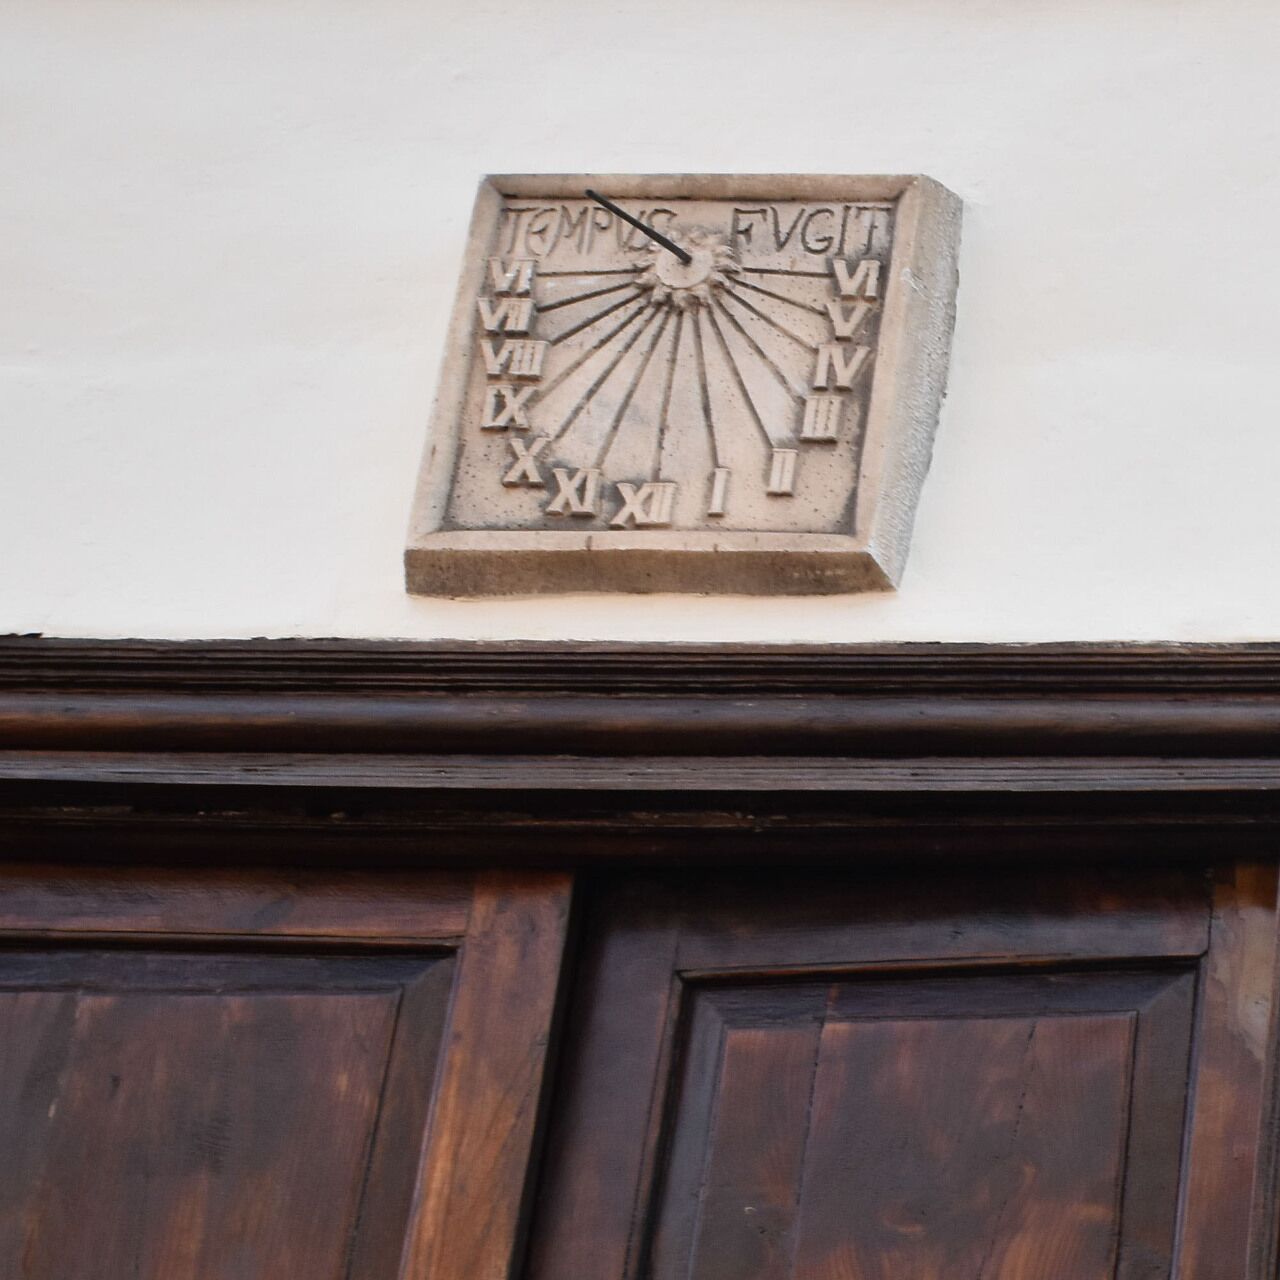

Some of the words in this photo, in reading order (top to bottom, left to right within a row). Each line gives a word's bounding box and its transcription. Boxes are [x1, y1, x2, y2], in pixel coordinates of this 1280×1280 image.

[733, 205, 893, 257] FVGIT
[488, 256, 536, 295] VI
[833, 256, 880, 301] VI
[477, 298, 534, 335] VII
[826, 303, 872, 340] V
[813, 344, 870, 390] IV
[481, 386, 538, 430] IX
[503, 438, 550, 486] X
[546, 468, 601, 517] XI
[609, 482, 677, 528] XII
